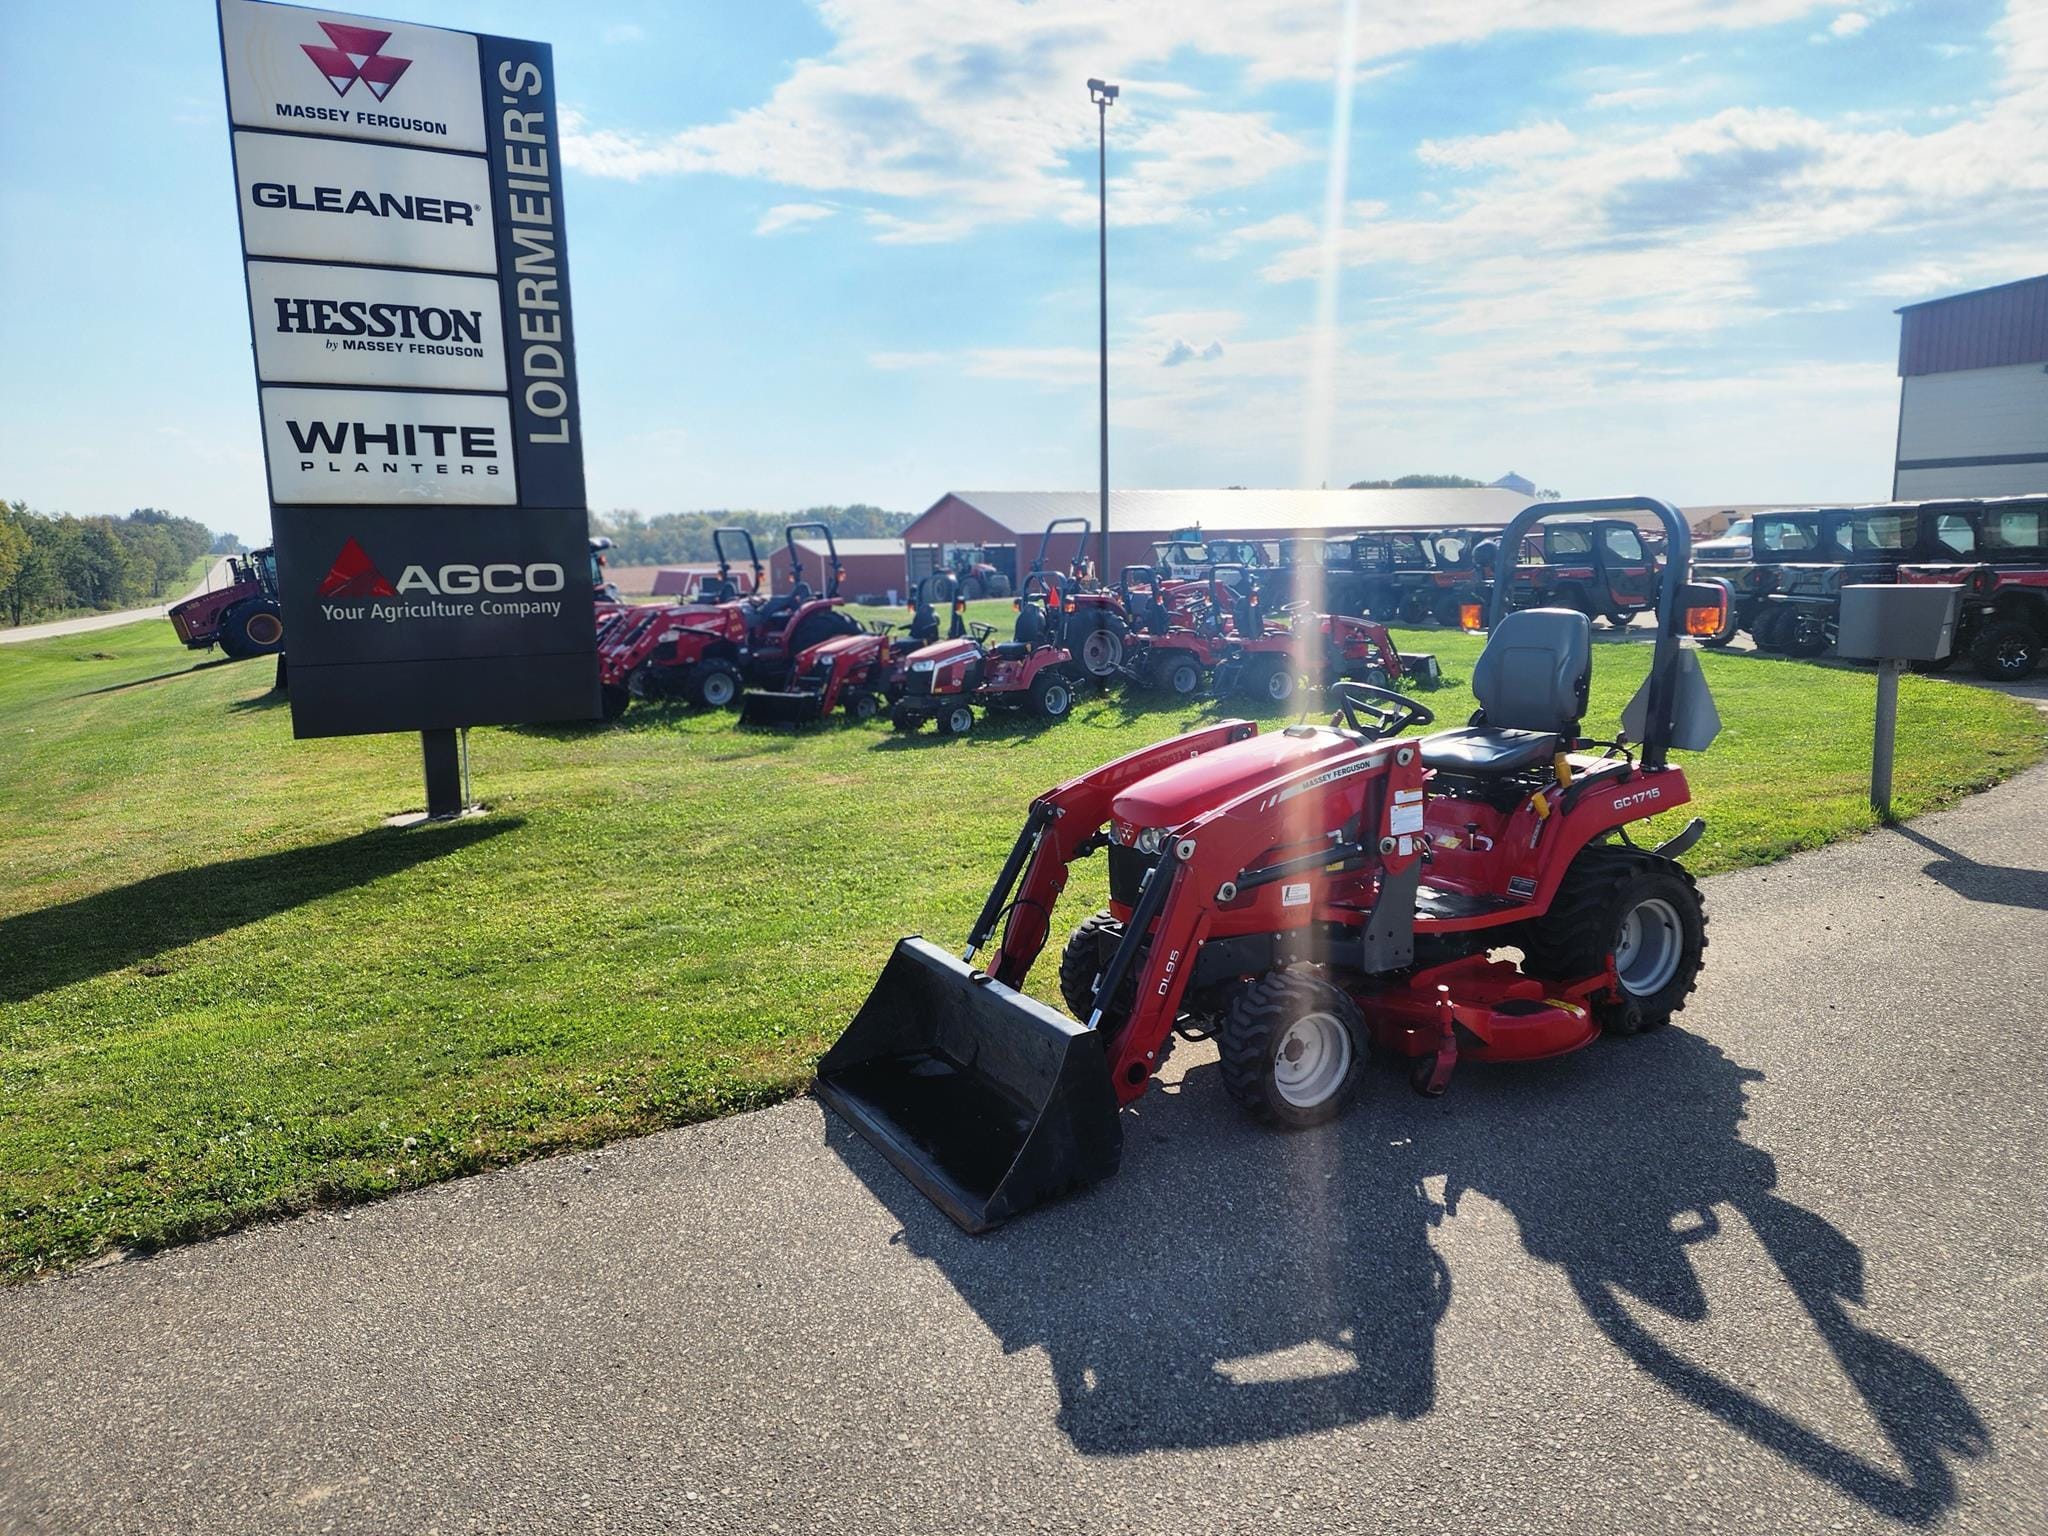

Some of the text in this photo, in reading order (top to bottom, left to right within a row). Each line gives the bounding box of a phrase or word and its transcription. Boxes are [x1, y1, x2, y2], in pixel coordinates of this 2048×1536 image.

[276, 103, 448, 136] MASSEY FERGUSON
[498, 60, 571, 445] LODERMEIER'S
[273, 298, 482, 344] HESSTON
[325, 338, 484, 358] by MASSEY FERGUSON
[285, 420, 498, 458] WHITE
[300, 461, 499, 476] PLANTERS
[395, 562, 565, 596] AGCO
[321, 599, 562, 623] Your Agriculture Company
[1302, 760, 1371, 790] MASSEY FERGUSON
[1157, 949, 1180, 996] DL95
